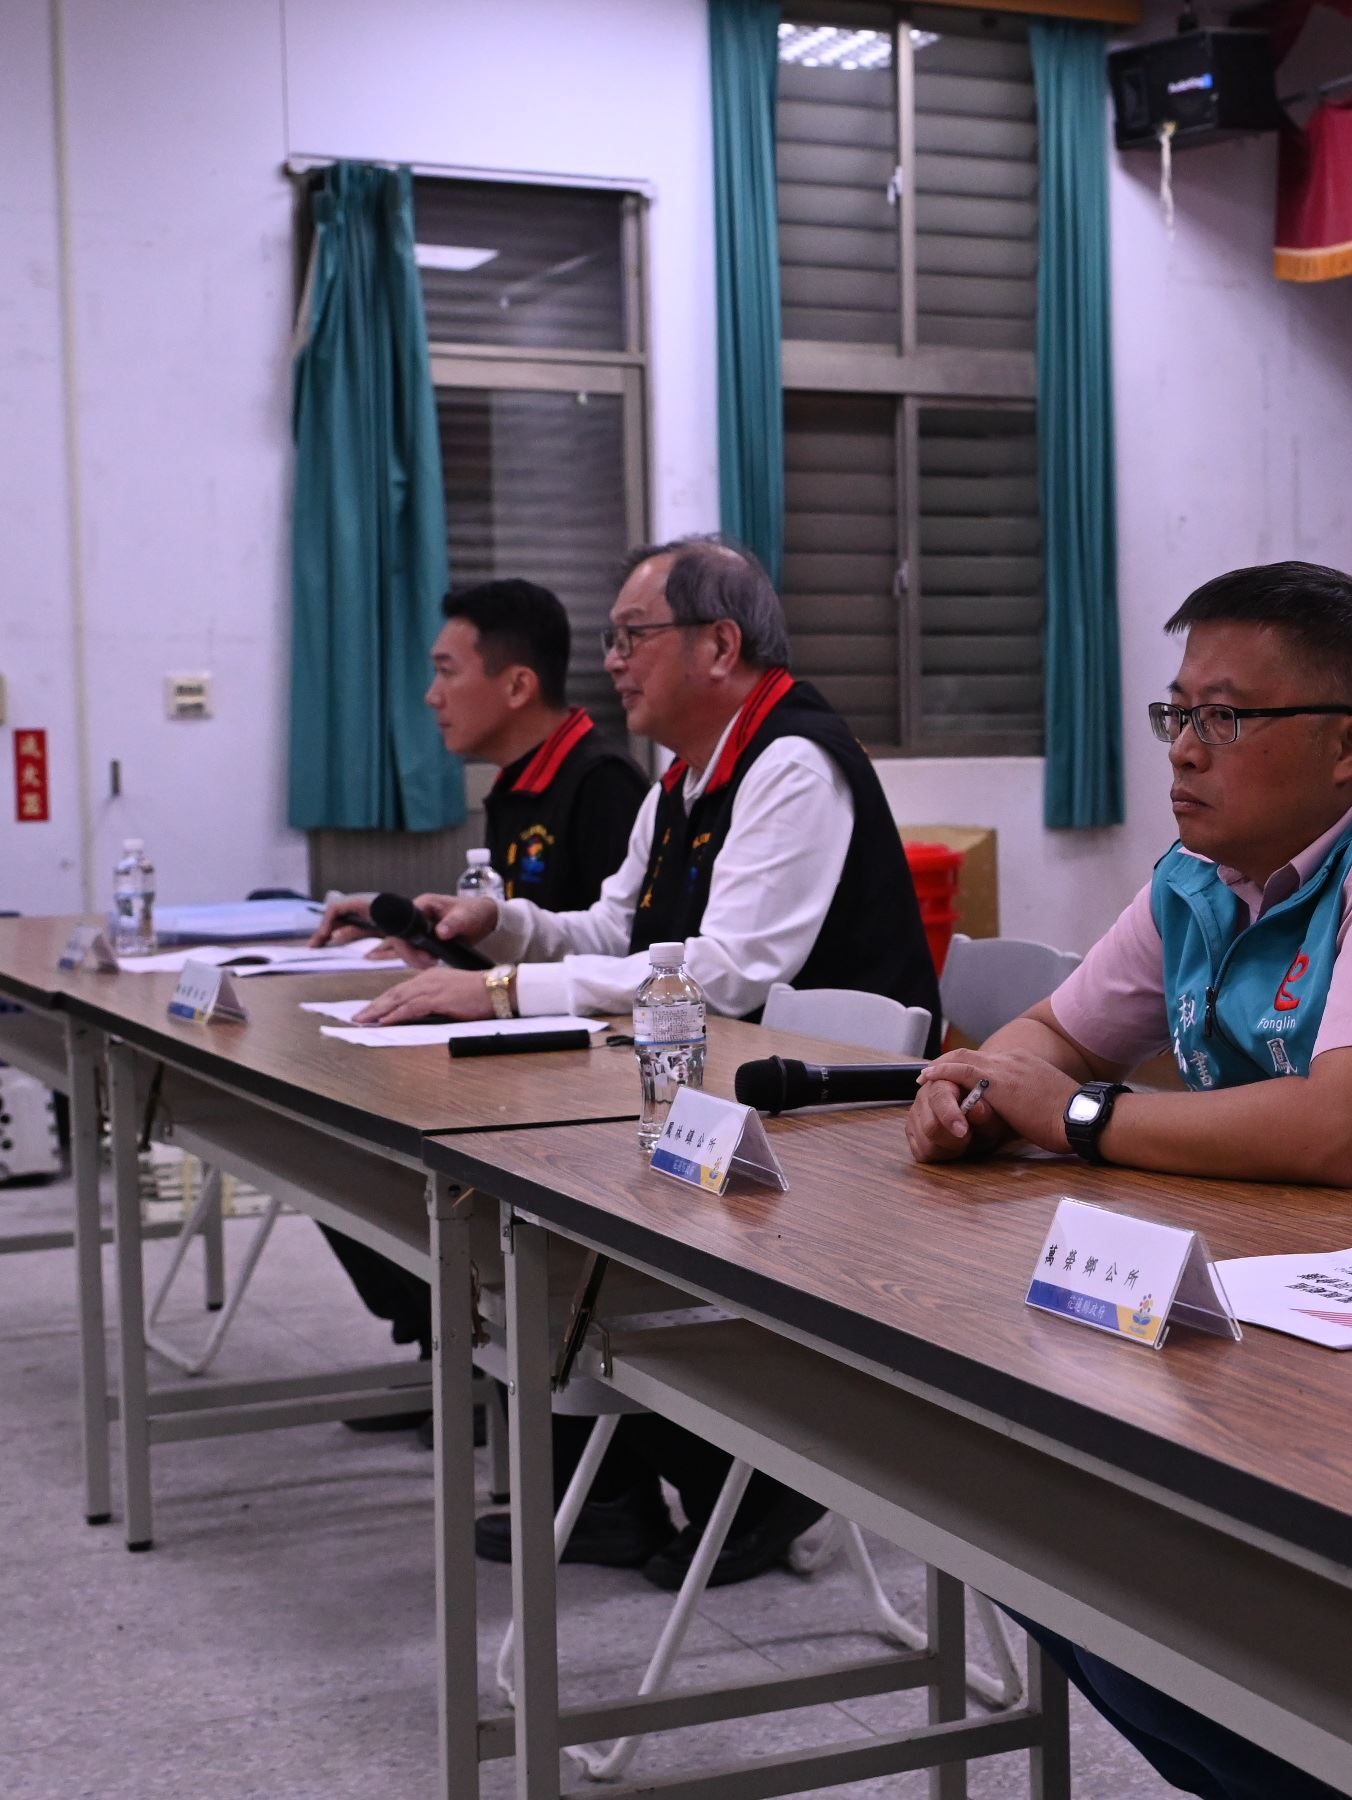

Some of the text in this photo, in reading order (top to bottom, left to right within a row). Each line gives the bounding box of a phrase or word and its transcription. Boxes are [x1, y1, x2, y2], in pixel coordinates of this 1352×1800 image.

[1256, 1015, 1297, 1032] Fonglin
[1043, 1243, 1141, 1291] 萬榮鄉公所
